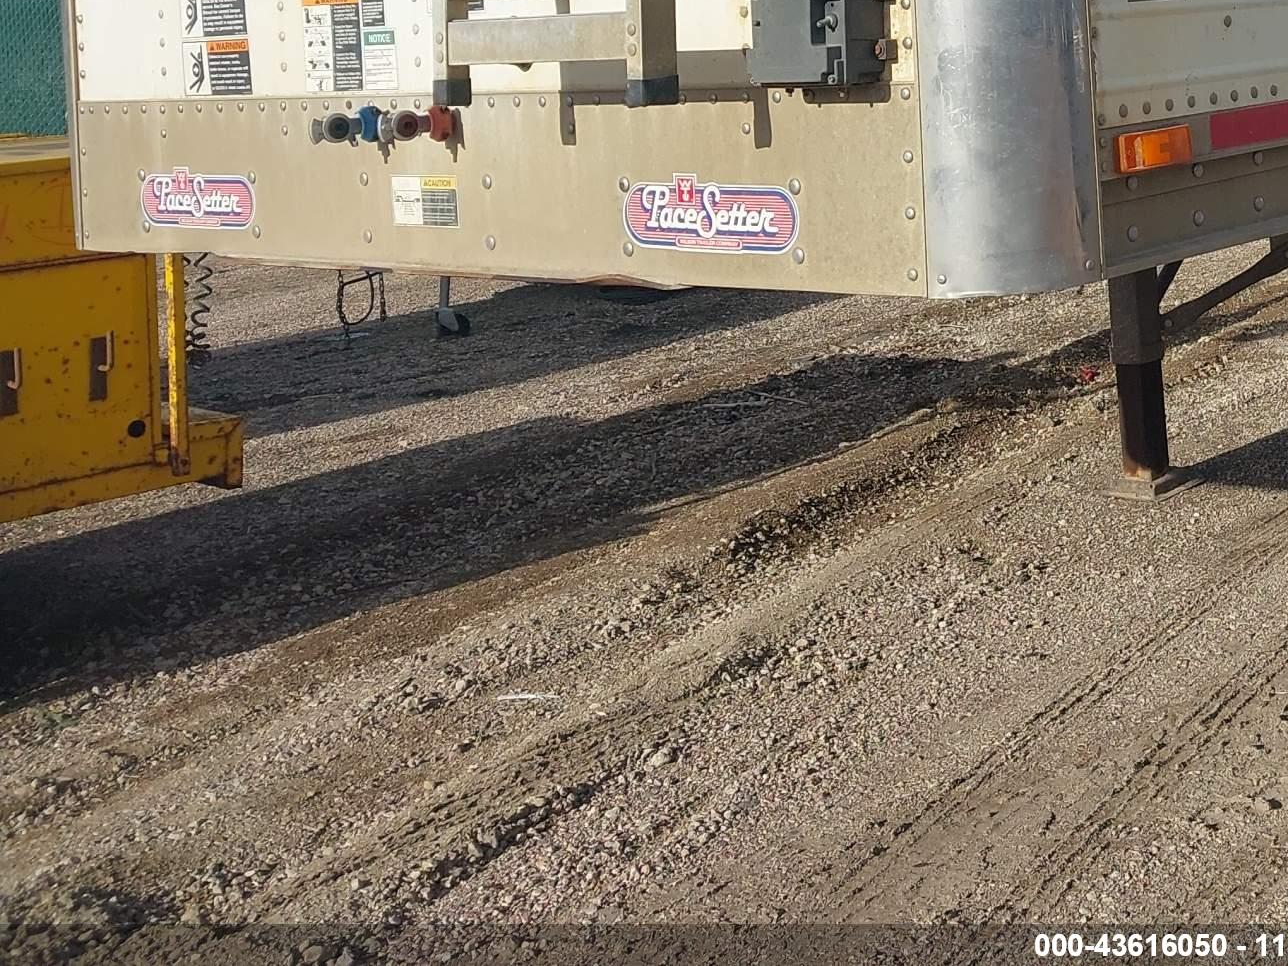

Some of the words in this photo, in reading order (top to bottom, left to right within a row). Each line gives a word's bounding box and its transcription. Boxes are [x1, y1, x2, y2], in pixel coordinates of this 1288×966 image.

[368, 33, 393, 43] NOTICE
[216, 41, 246, 50] WARNING
[428, 179, 451, 187] CAUTION
